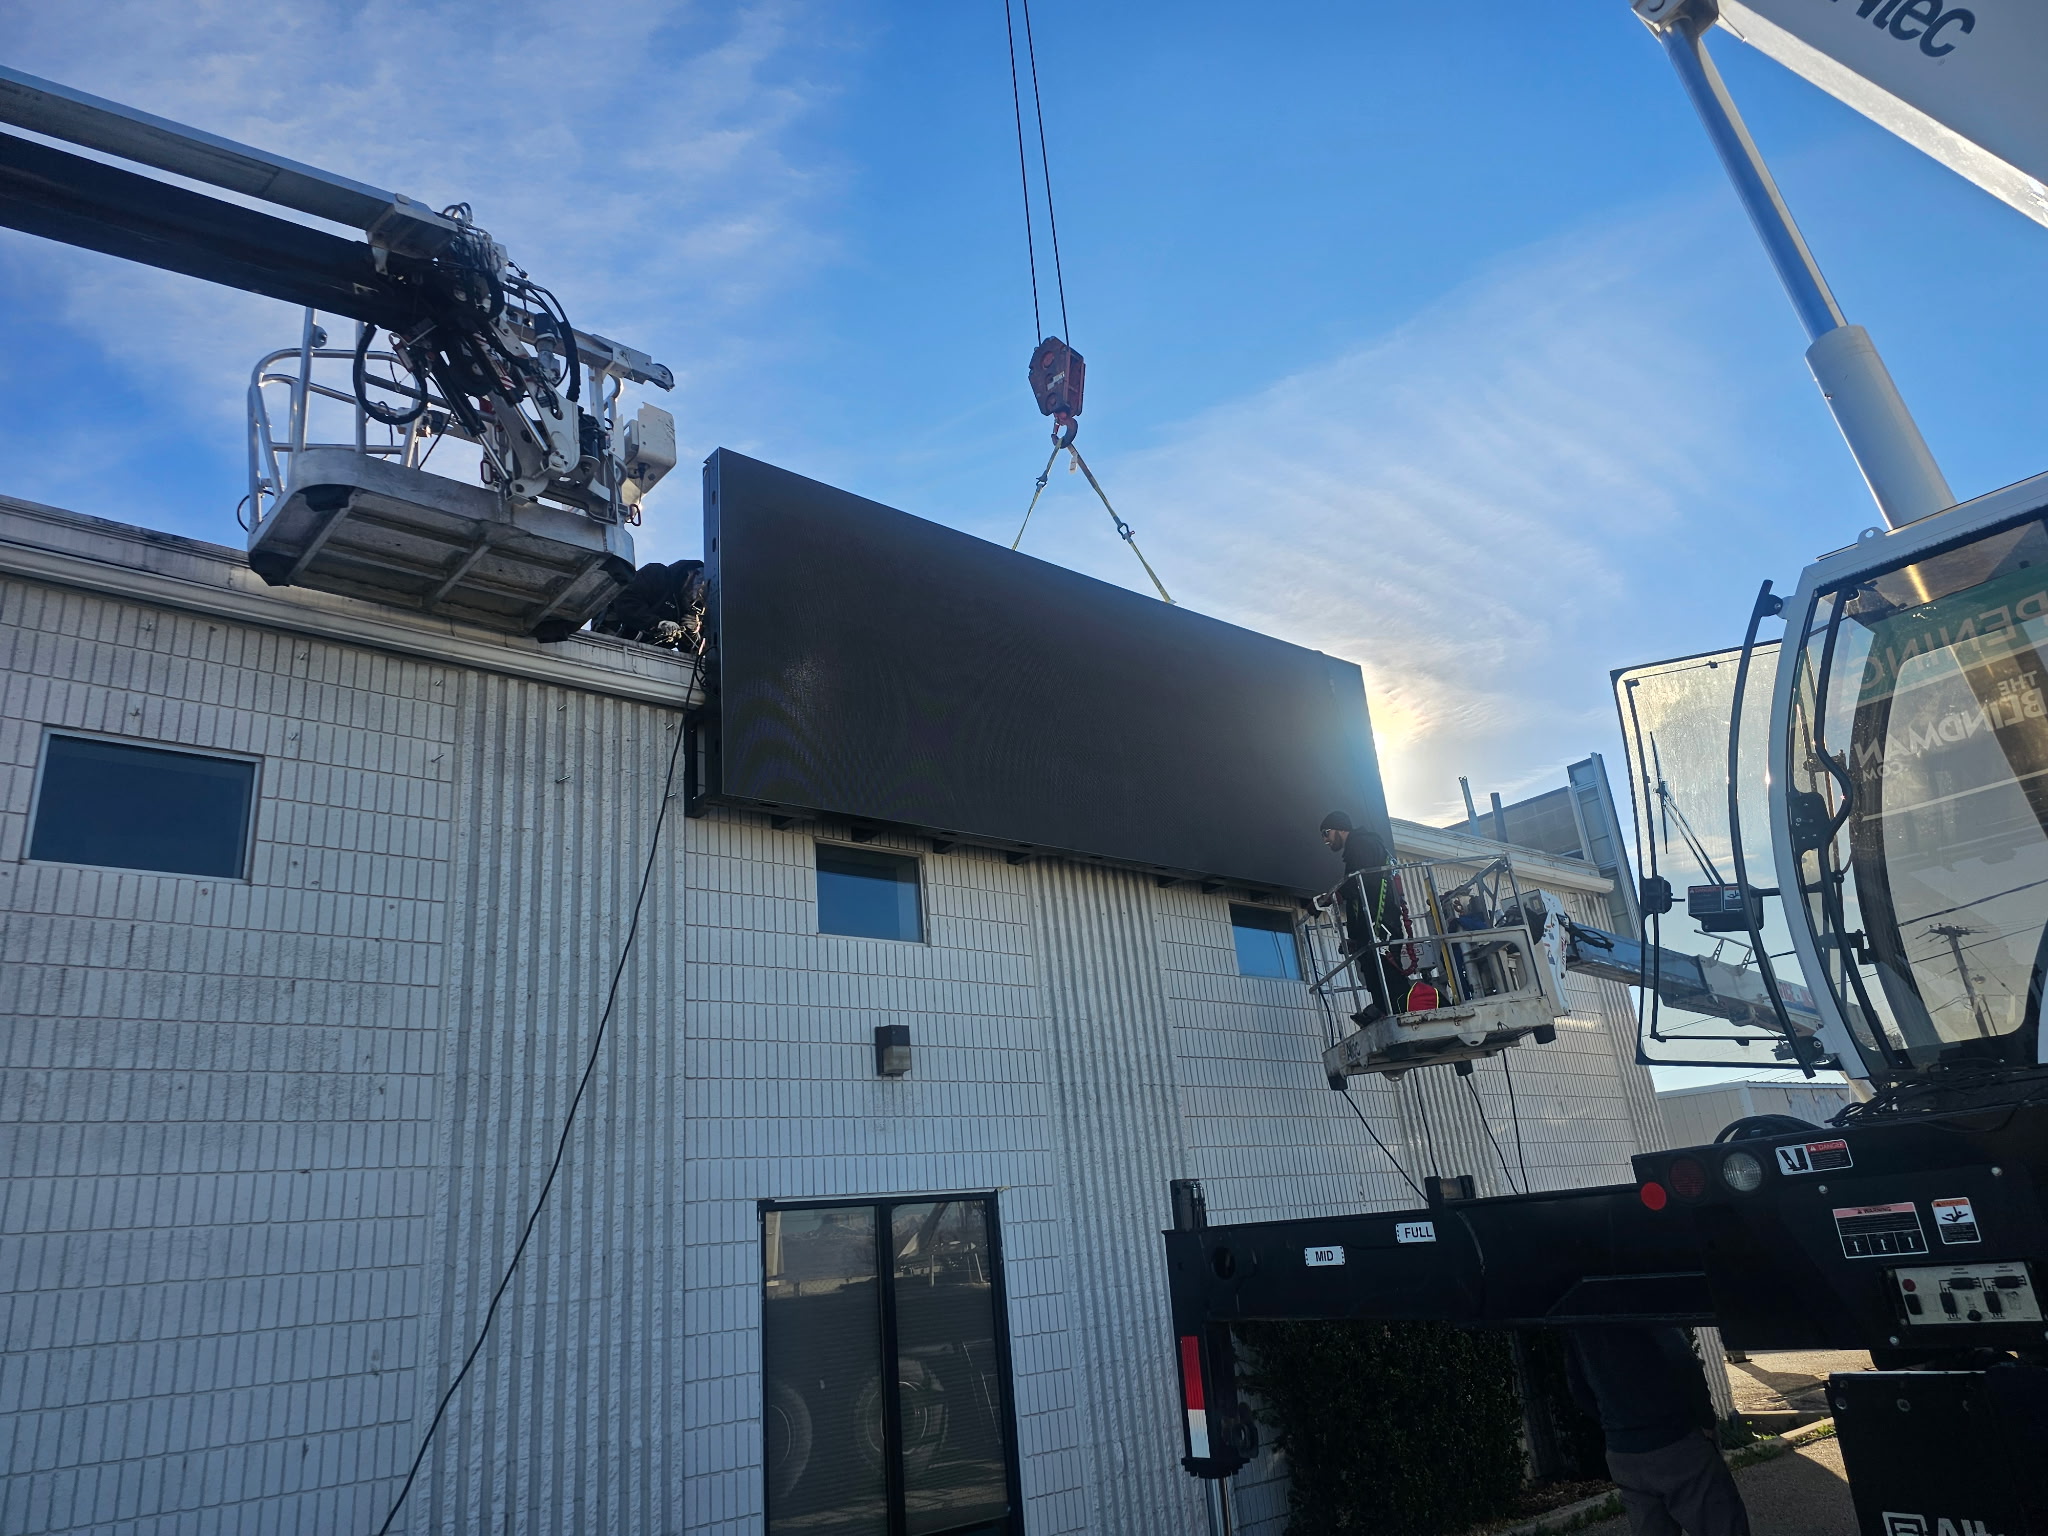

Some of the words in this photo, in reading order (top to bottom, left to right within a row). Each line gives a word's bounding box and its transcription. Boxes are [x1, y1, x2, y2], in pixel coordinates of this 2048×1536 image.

[1817, 1142, 1844, 1151] DANGER
[1863, 1206, 1892, 1214] WARNING
[1404, 1226, 1434, 1239] FULL
[1315, 1250, 1334, 1262] MID
